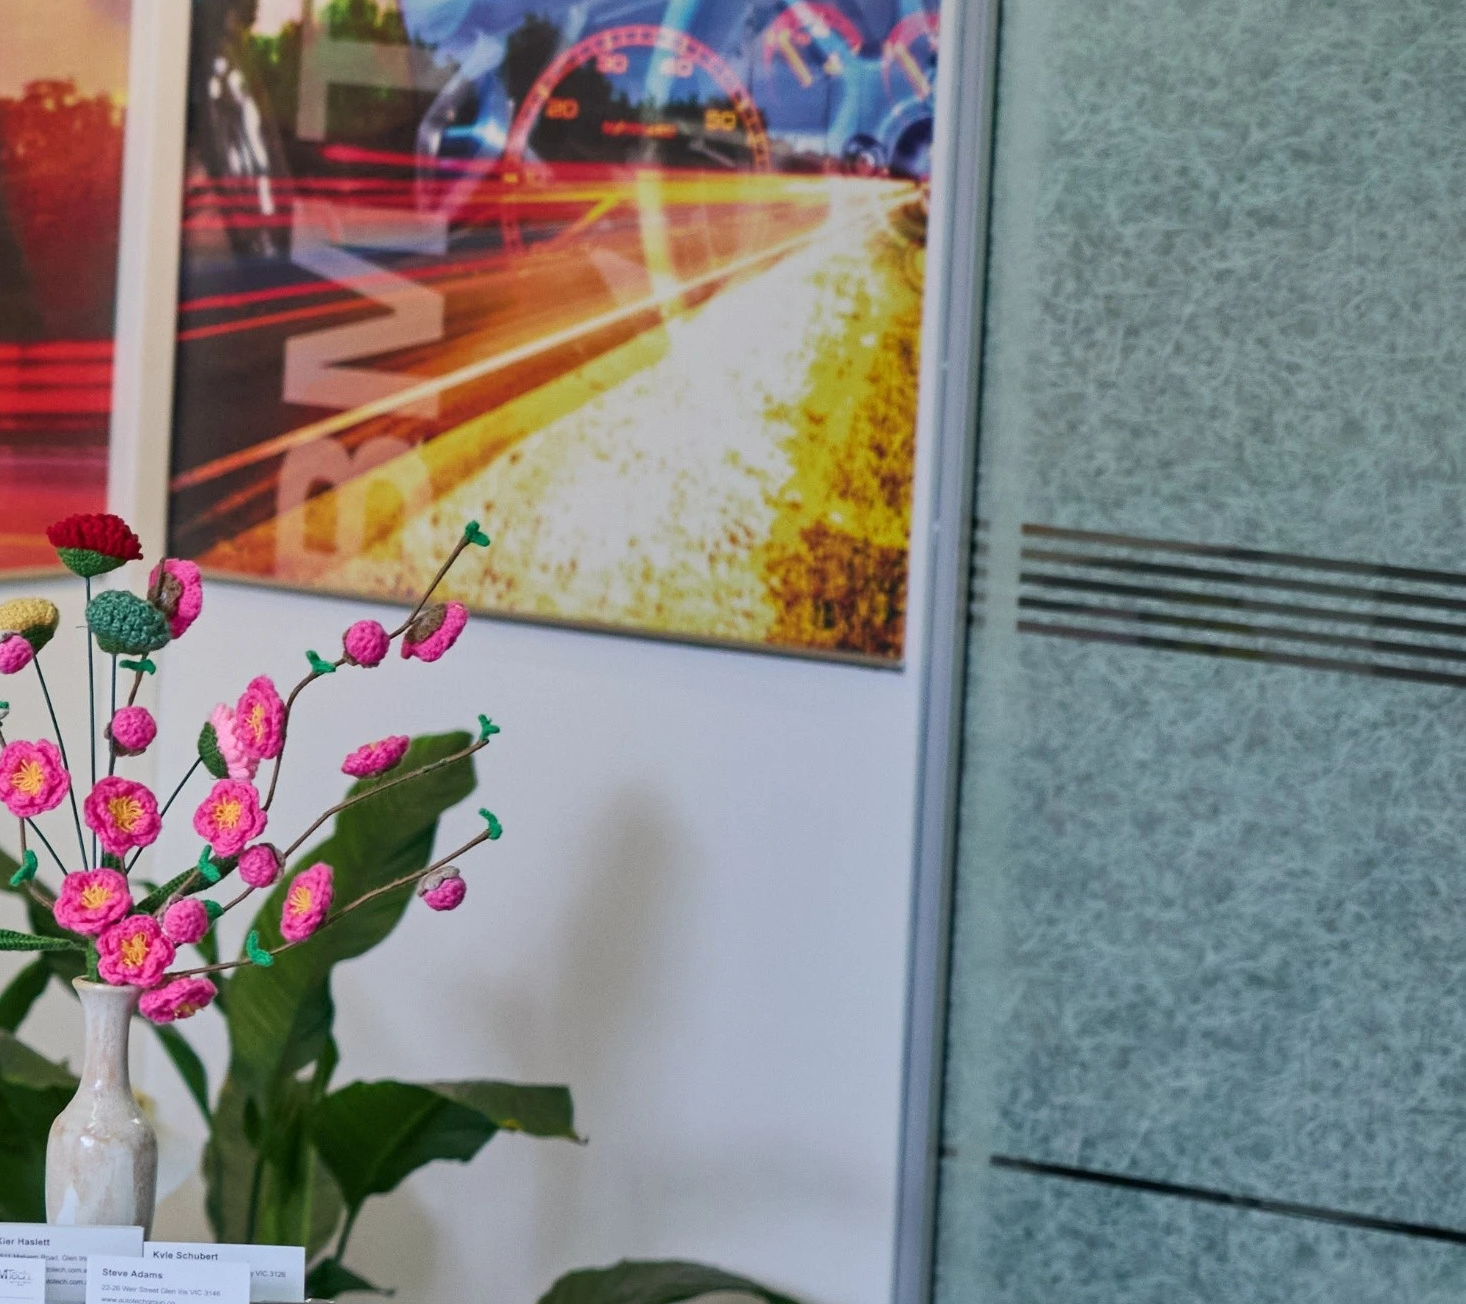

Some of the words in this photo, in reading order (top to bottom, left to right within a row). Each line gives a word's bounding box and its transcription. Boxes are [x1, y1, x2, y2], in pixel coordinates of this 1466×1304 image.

[274, 197, 449, 582] BM
[18, 1238, 51, 1246] Haslett
[176, 1251, 219, 1261] Schubert
[102, 1268, 128, 1278] Steve
[131, 1269, 163, 1280] Adams
[139, 1286, 159, 1294] Street
